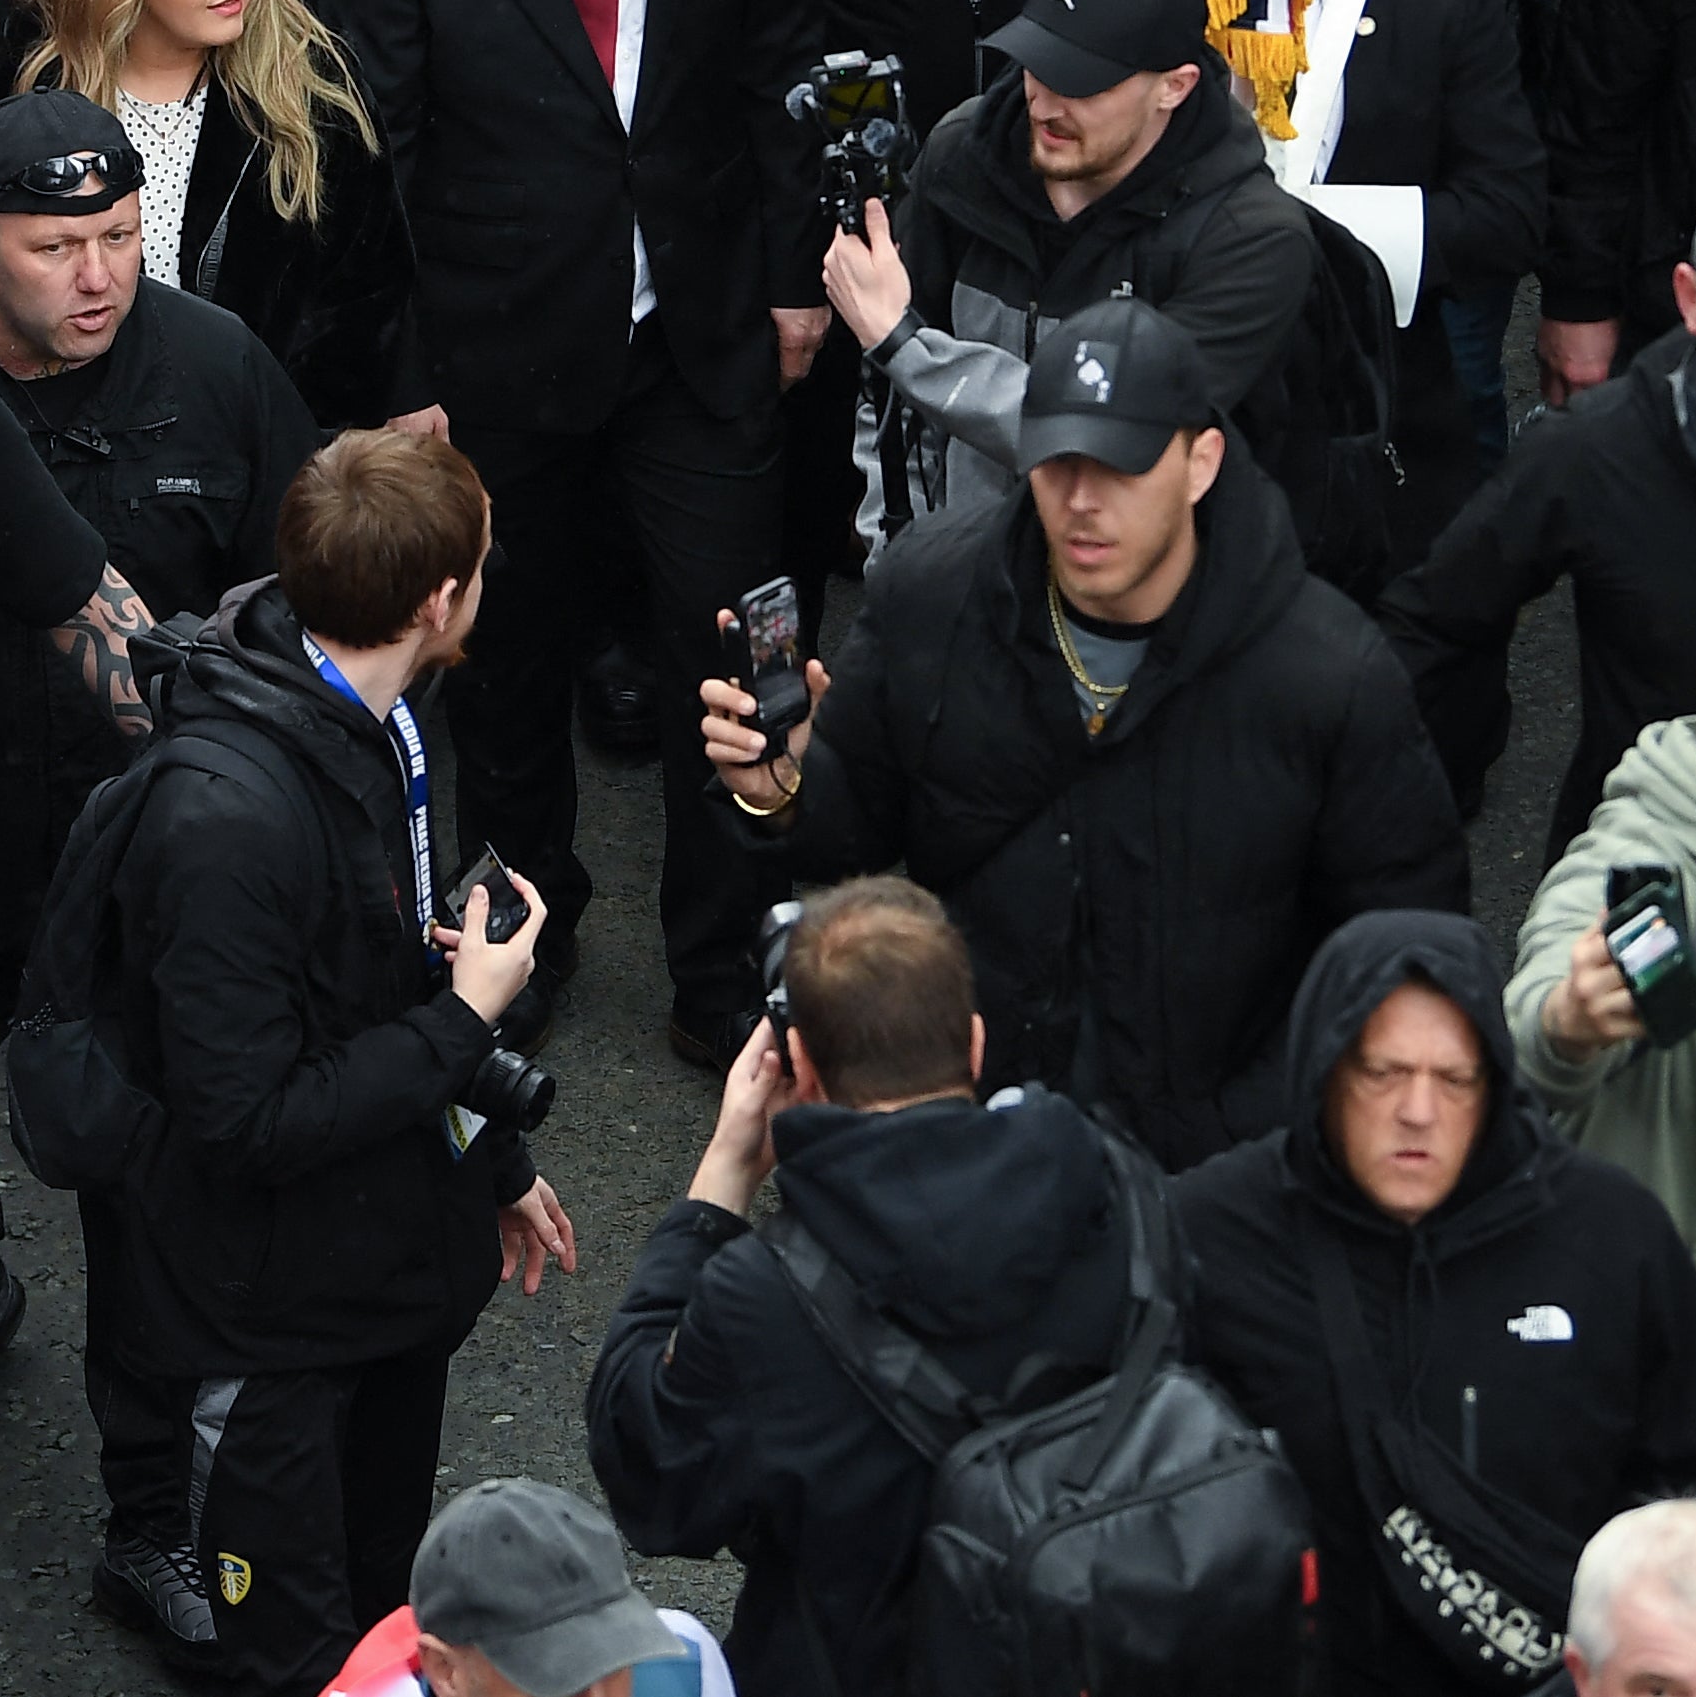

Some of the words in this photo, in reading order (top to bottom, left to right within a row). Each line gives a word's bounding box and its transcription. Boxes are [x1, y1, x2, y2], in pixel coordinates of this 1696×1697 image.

[392, 705, 423, 756] MEDIA
[411, 753, 426, 779] UK
[419, 850, 432, 898] MEDIA
